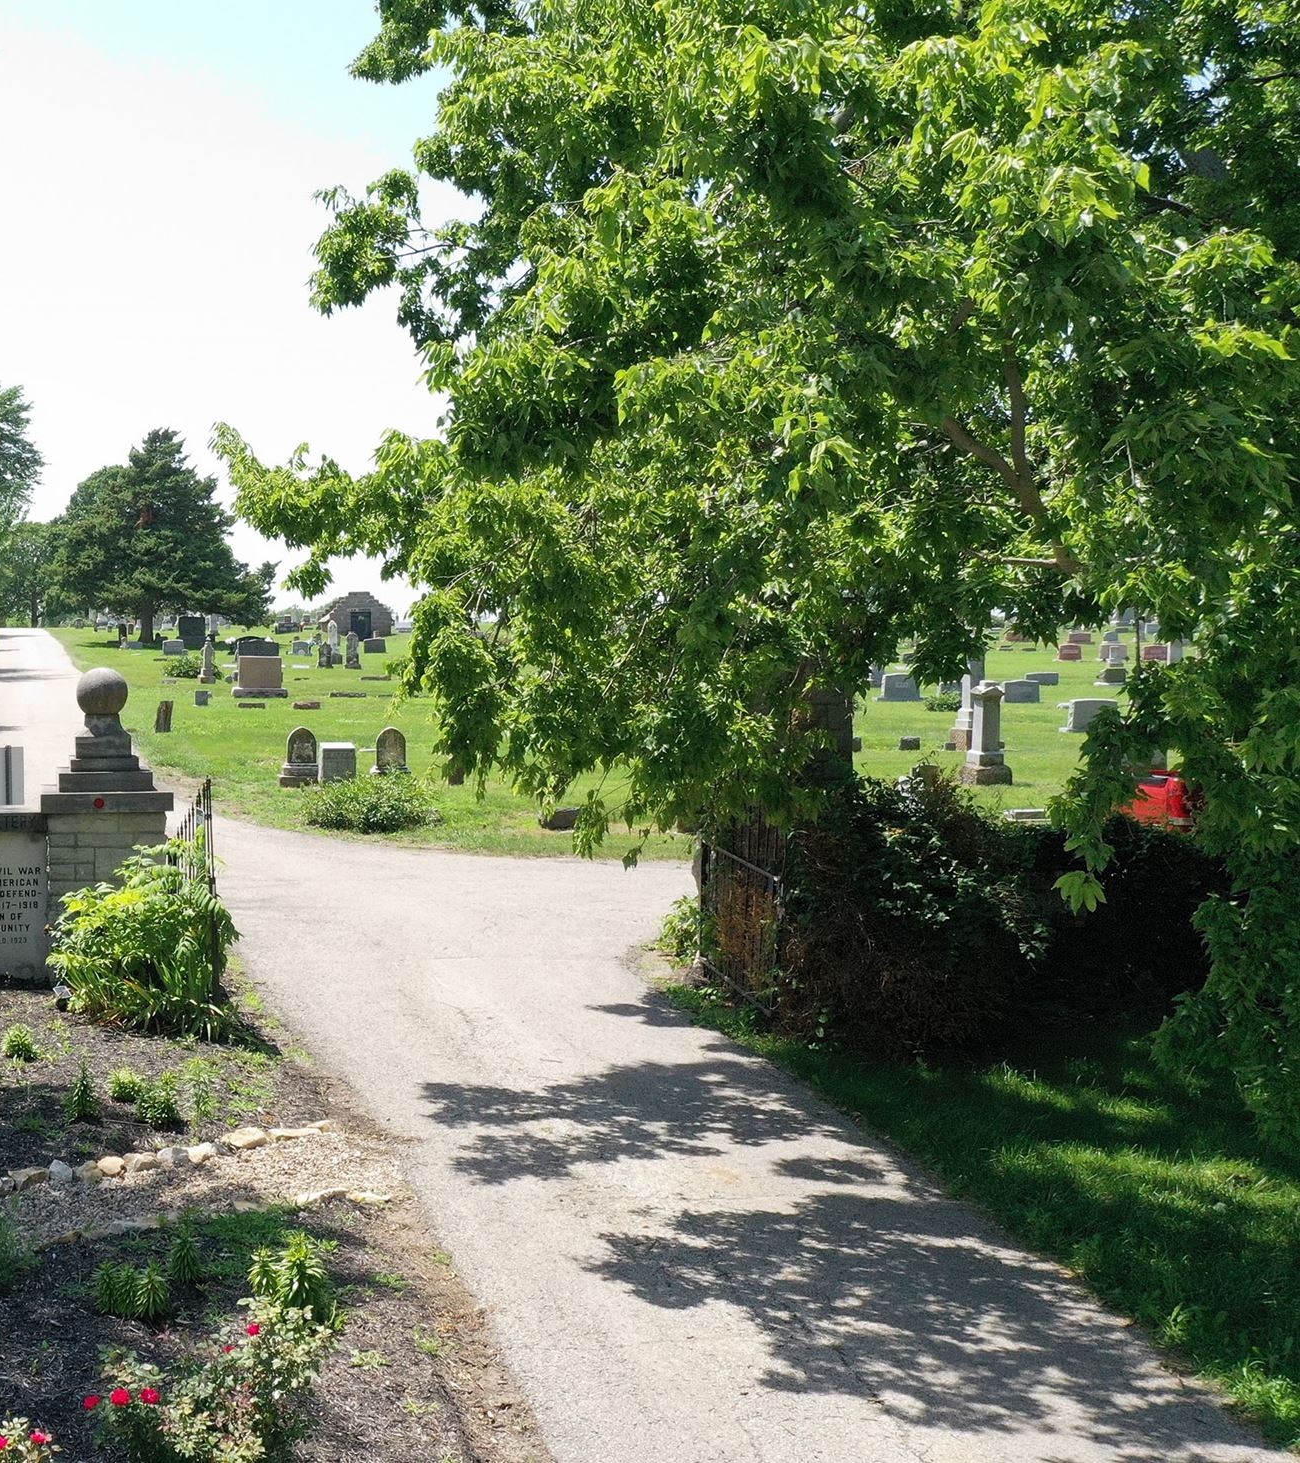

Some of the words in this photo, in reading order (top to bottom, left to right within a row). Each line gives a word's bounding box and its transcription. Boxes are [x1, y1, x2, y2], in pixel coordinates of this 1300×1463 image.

[18, 866, 42, 875] WAR
[0, 890, 42, 898] DEFEND-
[10, 912, 24, 921] OF
